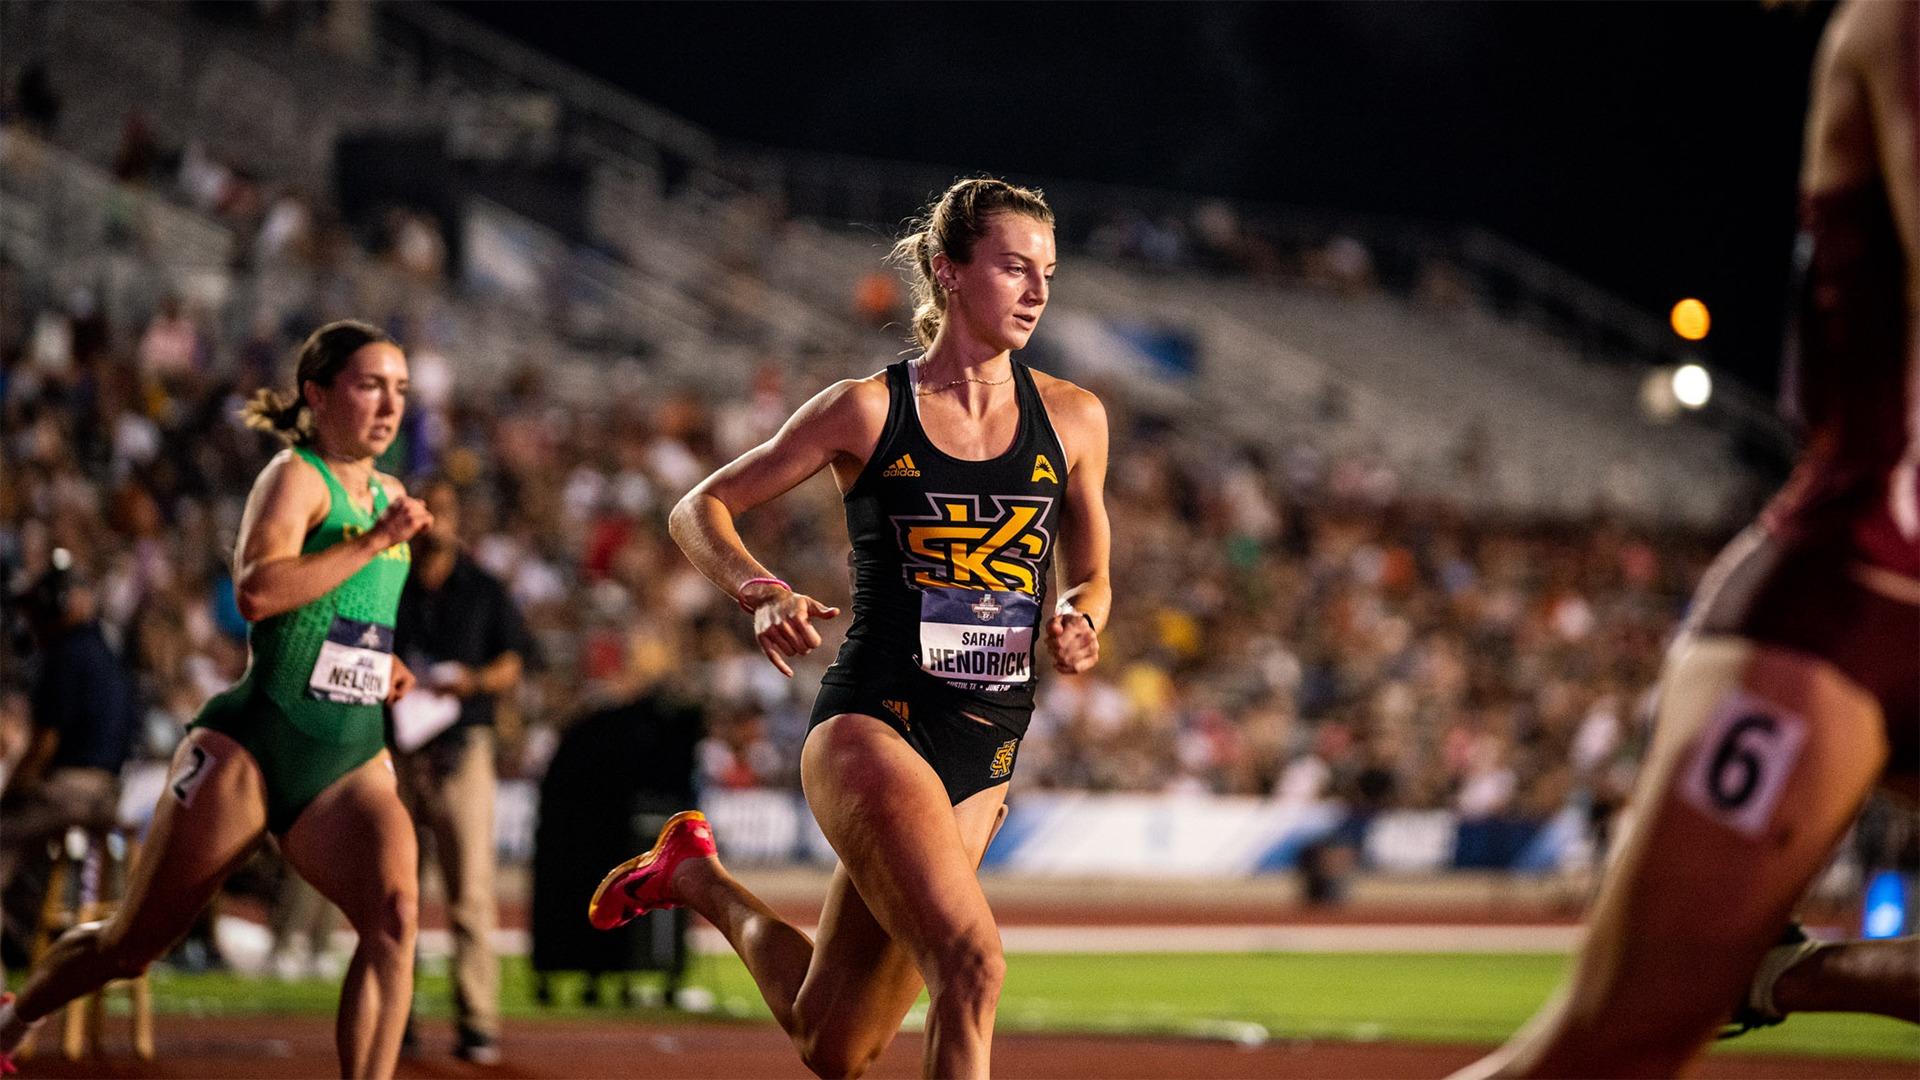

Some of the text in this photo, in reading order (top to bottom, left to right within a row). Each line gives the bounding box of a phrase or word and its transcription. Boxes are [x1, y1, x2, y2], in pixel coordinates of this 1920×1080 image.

[883, 467, 921, 478] adidas
[961, 631, 1005, 648] SARAH
[928, 647, 1028, 677] HENDRICK
[173, 745, 206, 800] 2
[1709, 713, 1777, 812] 6
